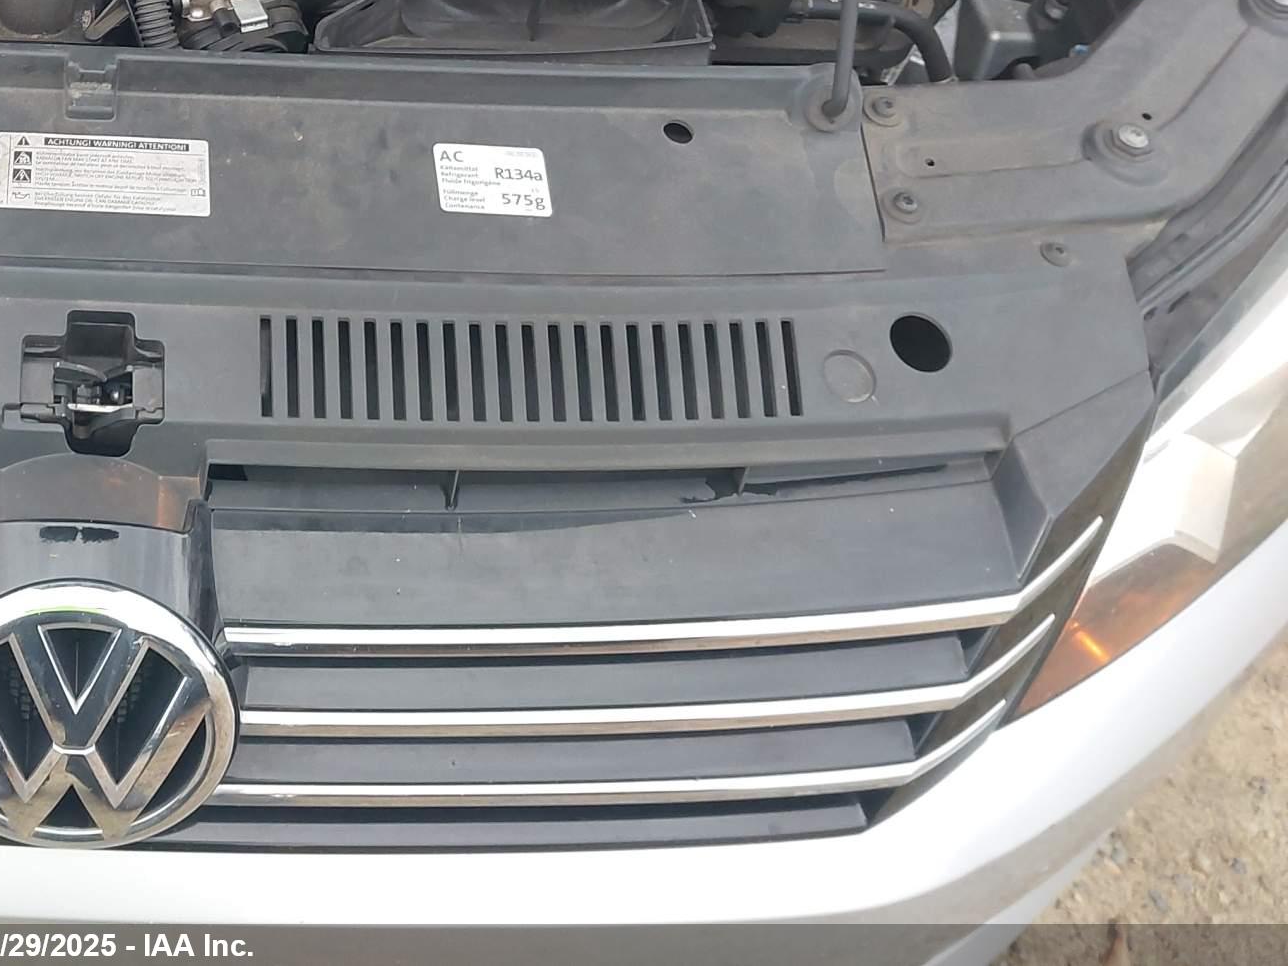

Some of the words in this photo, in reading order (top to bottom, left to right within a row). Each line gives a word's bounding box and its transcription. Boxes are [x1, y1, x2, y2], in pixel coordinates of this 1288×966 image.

[48, 138, 91, 146] ACHTUNG!
[93, 140, 136, 148] WARNING!
[138, 142, 186, 151] ATTENTION!
[440, 150, 464, 162] AC
[494, 167, 543, 181] R134a
[501, 193, 546, 211] 575g
